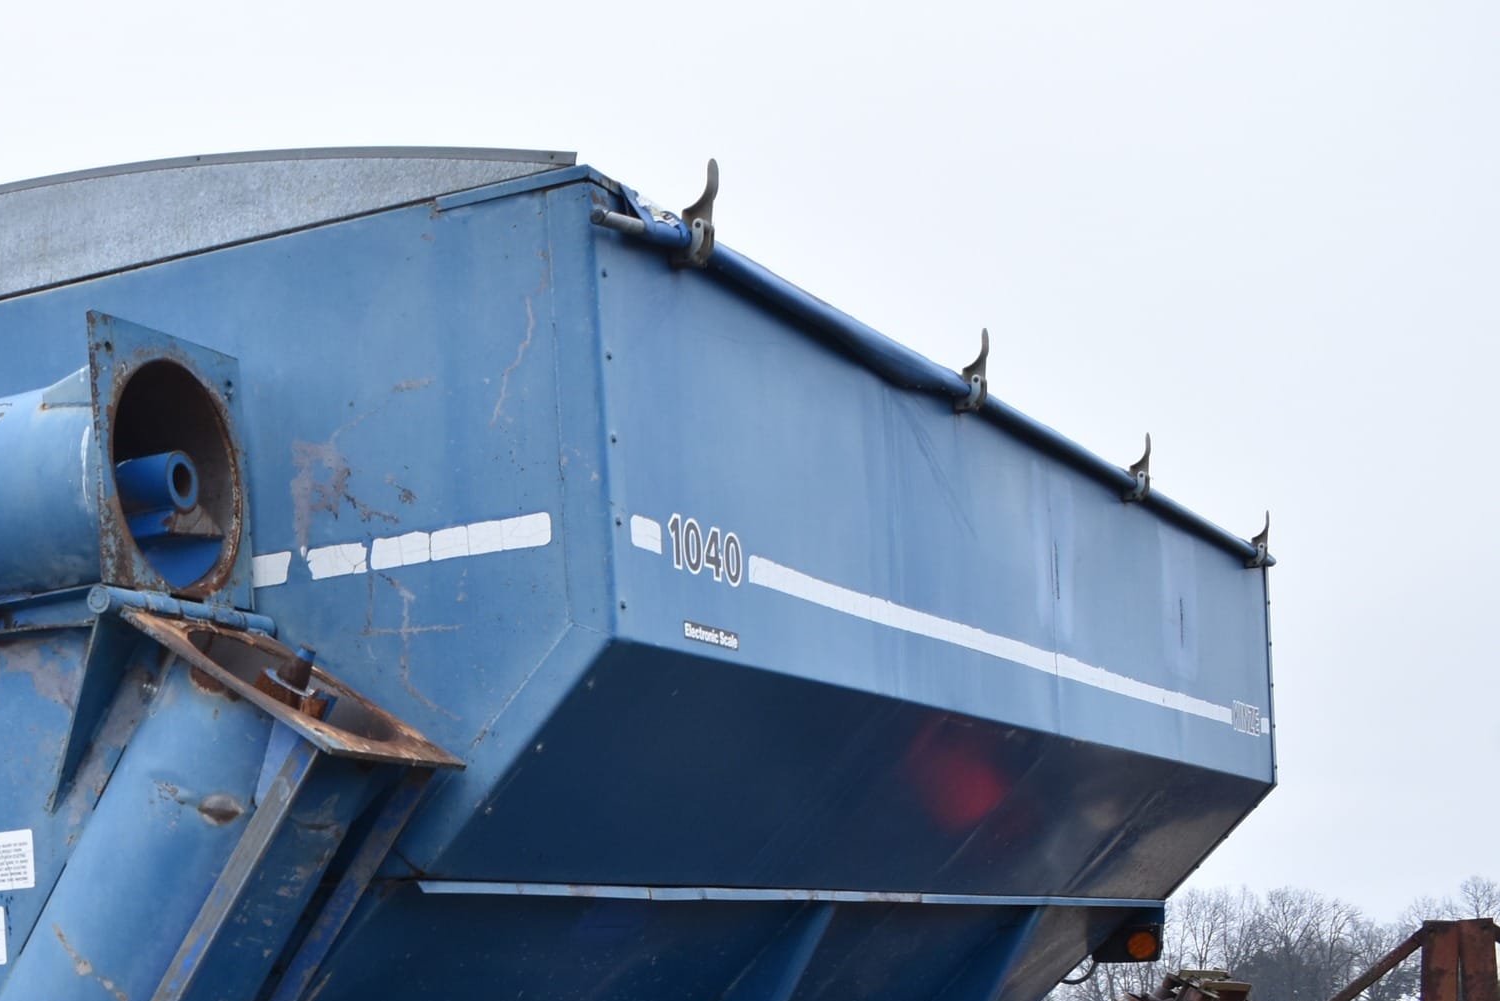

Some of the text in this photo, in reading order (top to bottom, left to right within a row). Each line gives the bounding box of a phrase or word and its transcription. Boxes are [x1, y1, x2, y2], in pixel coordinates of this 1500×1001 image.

[667, 513, 743, 588] 1040
[684, 622, 738, 649] Electronic Scale
